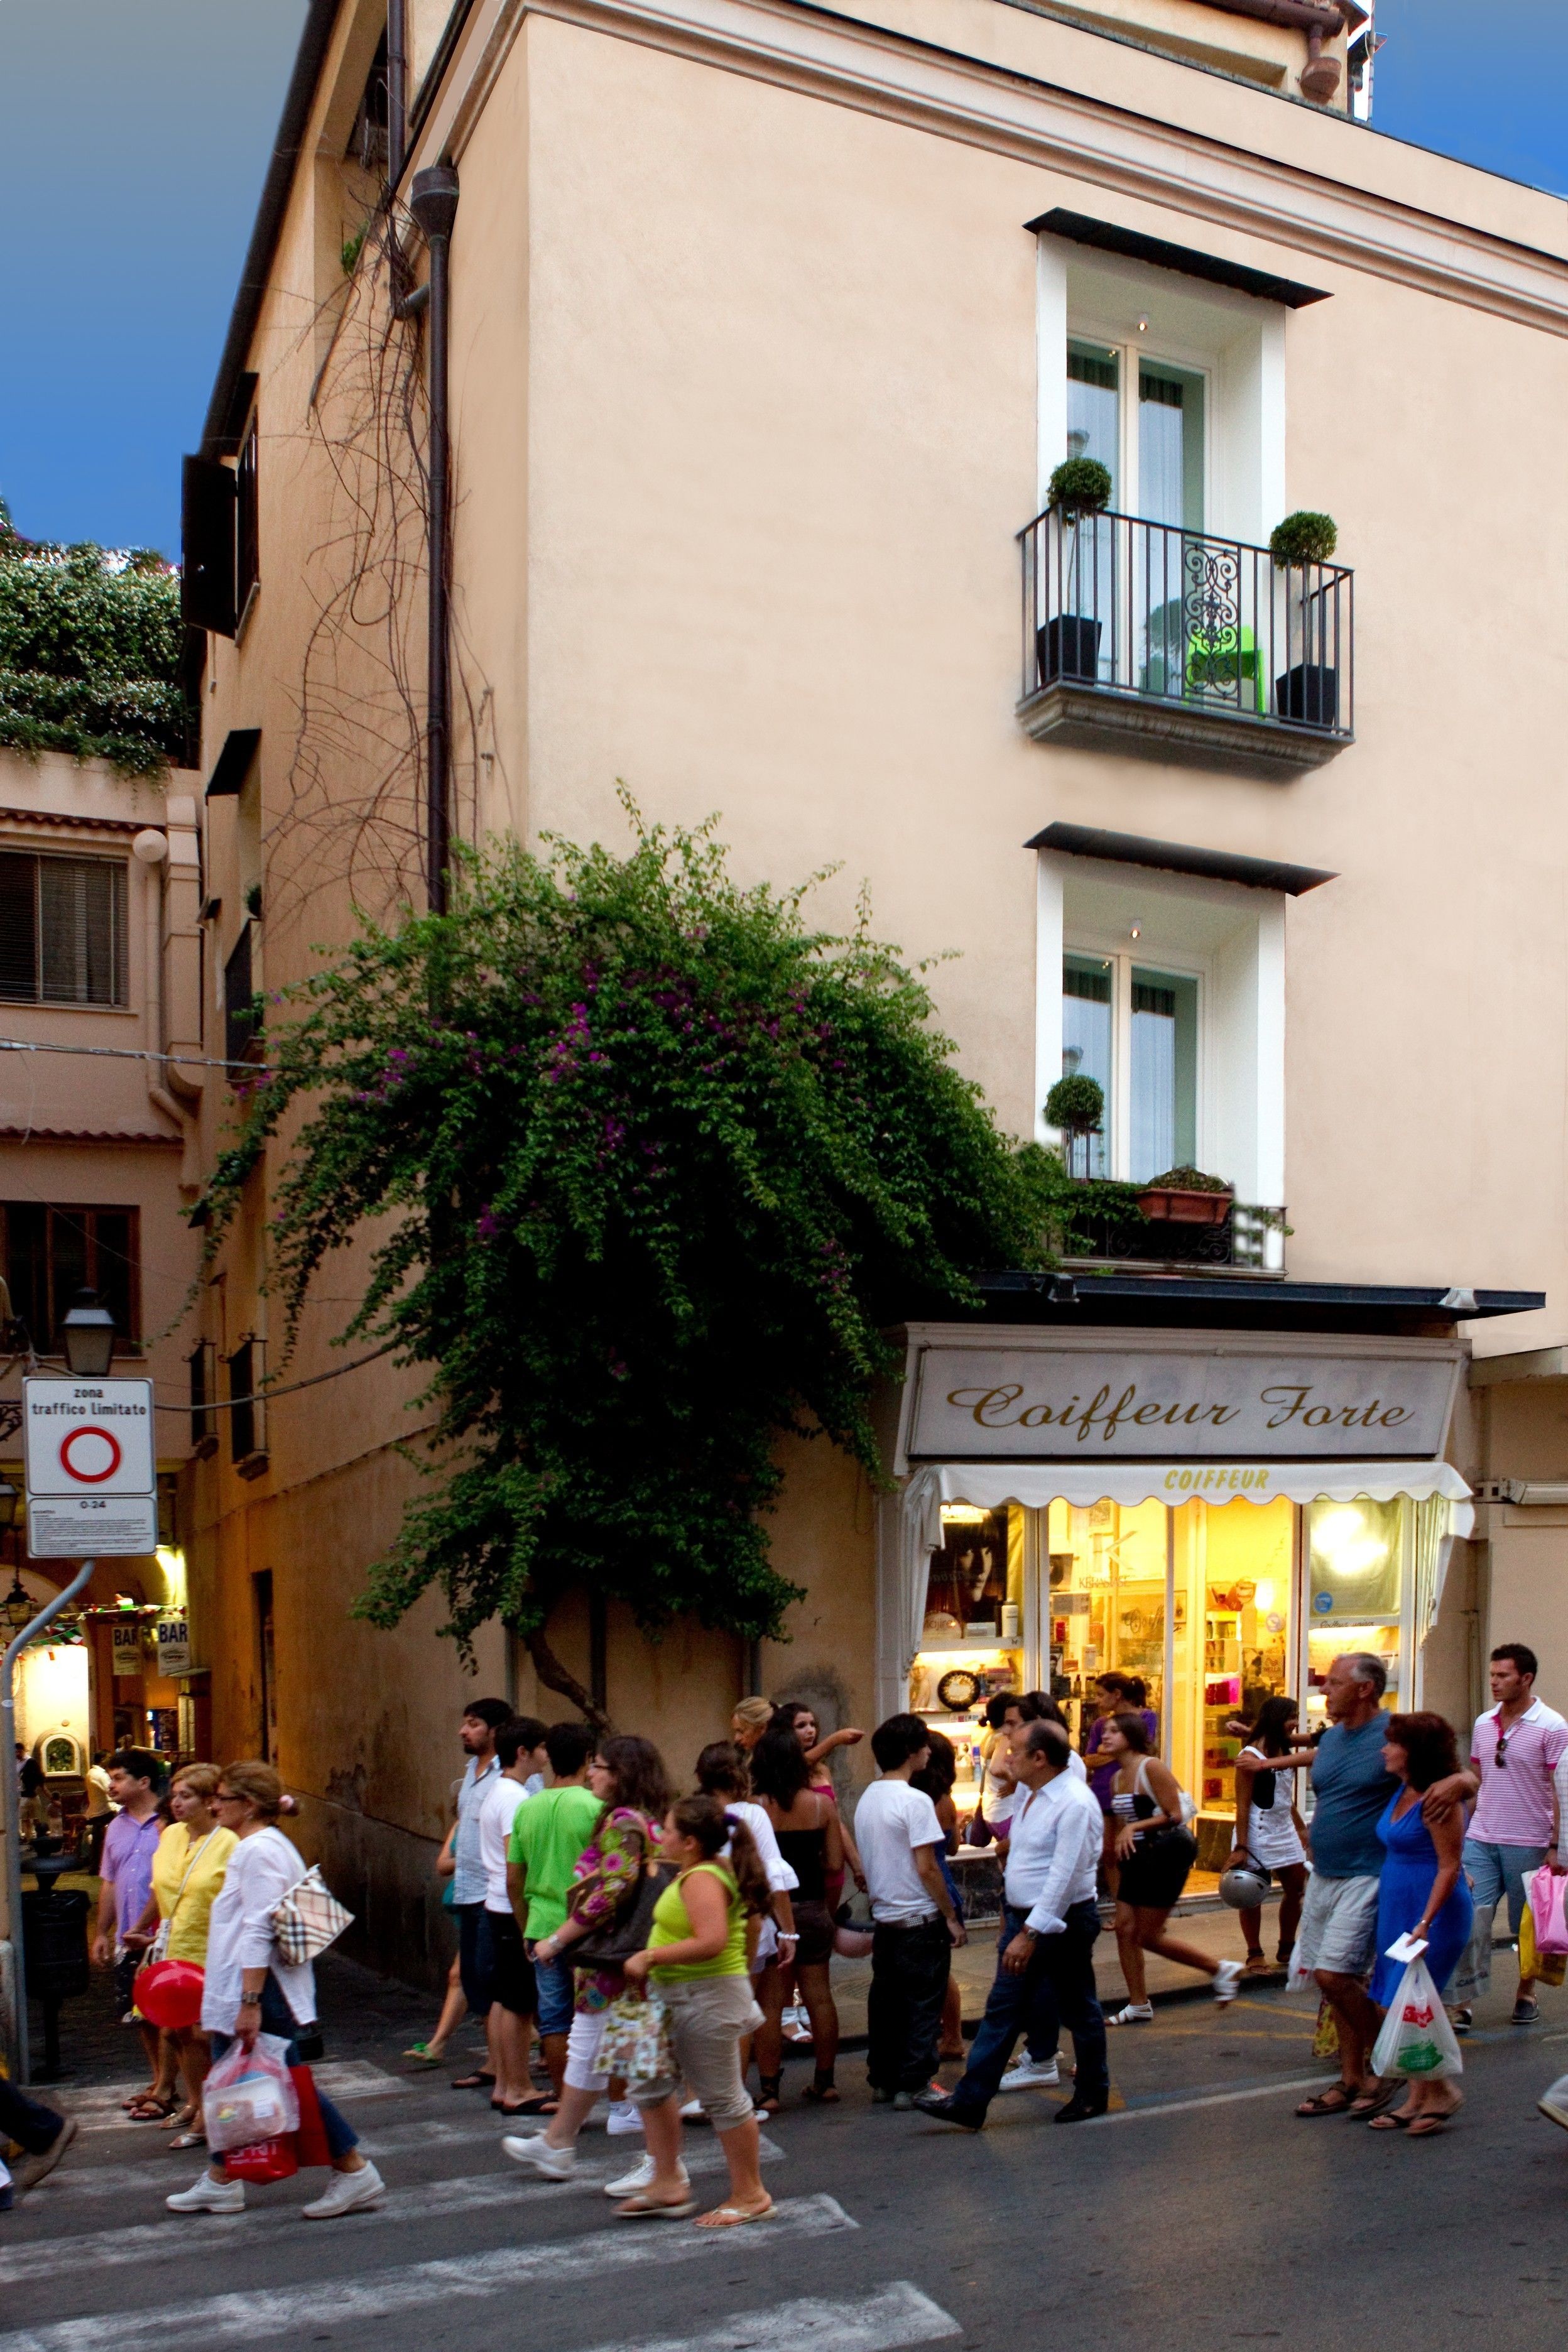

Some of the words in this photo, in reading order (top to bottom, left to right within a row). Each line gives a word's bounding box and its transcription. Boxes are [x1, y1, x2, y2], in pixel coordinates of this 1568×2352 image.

[74, 1389, 104, 1398] zona
[33, 1403, 86, 1415] traffico
[91, 1402, 146, 1415] limitato
[947, 1384, 1240, 1441] Coiffeur
[1261, 1386, 1415, 1428] Forte
[1164, 1469, 1270, 1490] COIFFEUR
[160, 1623, 187, 1643] BAR
